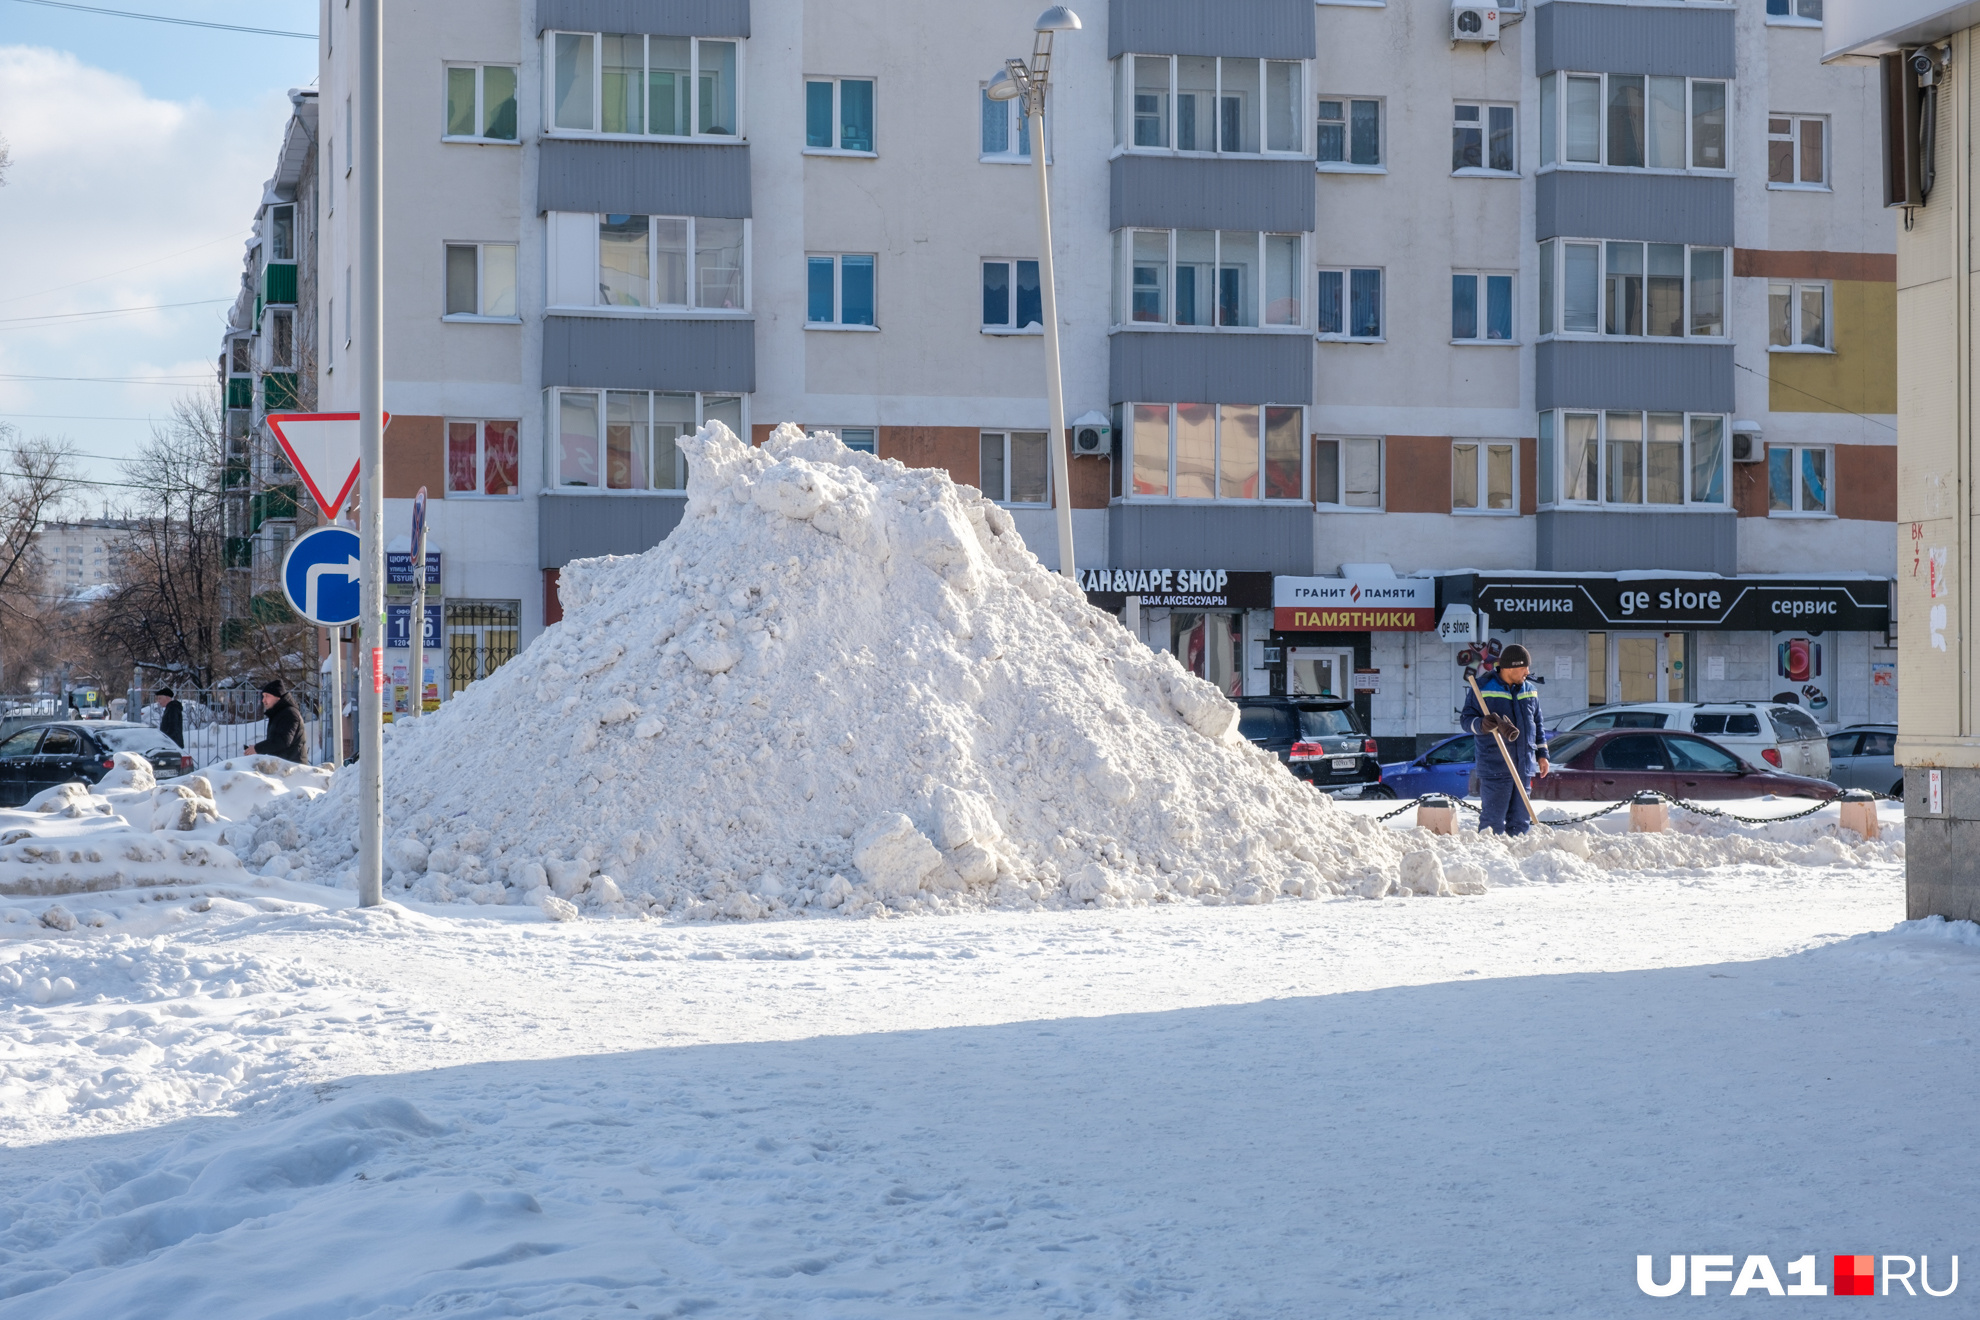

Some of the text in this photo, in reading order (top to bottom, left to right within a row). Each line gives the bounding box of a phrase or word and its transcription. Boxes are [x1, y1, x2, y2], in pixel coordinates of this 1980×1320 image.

[389, 555, 411, 563] ЦЮРУ
[1913, 558, 1920, 578] 7
[1176, 568, 1228, 593] SHOP
[1162, 595, 1228, 606] АКСЕССУАРЫ
[1295, 588, 1415, 598] ГРАНИТ ПАМЯТИ
[1619, 587, 1722, 616] ge store
[1493, 598, 1574, 612] техника
[1771, 599, 1838, 618] сервис
[1294, 611, 1416, 627] ПАМЯТНИКИ
[1441, 619, 1470, 638] ge store
